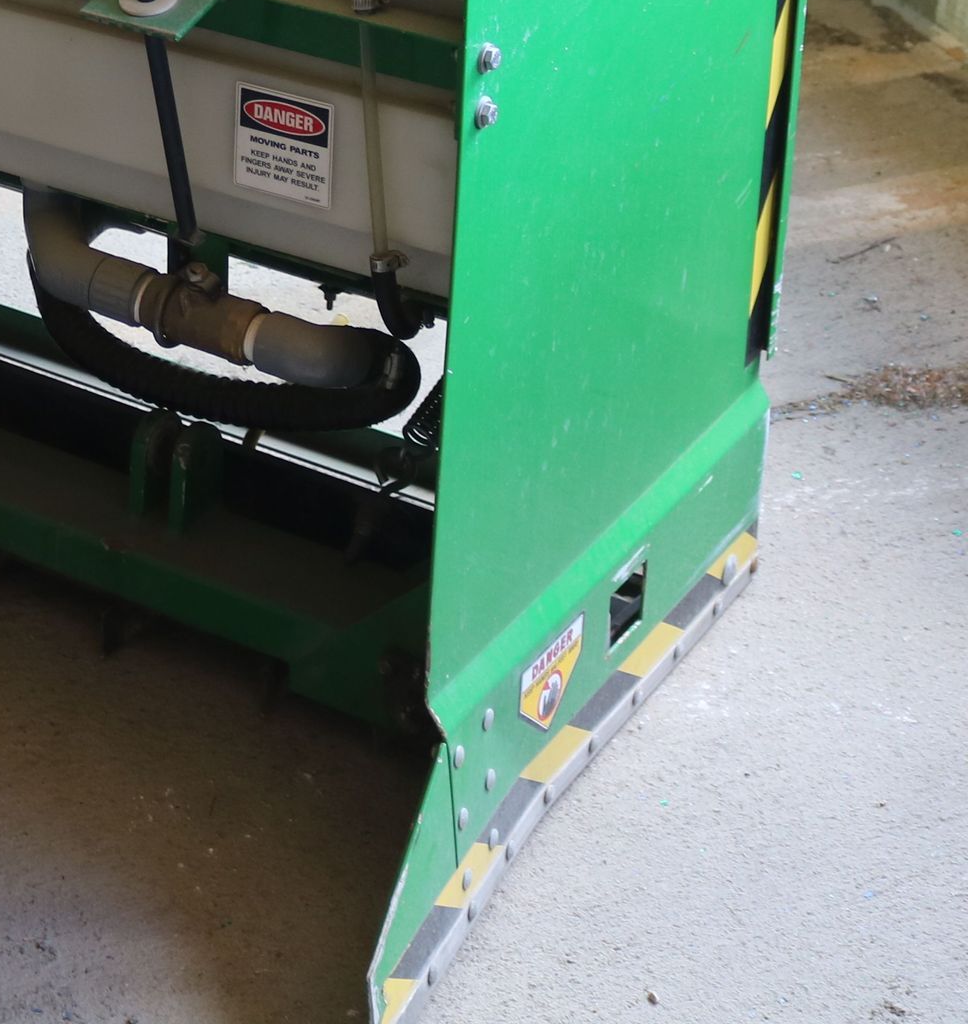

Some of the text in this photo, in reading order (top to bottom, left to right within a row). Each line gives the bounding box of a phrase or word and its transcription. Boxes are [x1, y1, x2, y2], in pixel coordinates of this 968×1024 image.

[253, 103, 314, 132] DANGER
[249, 135, 320, 159] MOVING PARTS
[240, 156, 271, 170] FINGERS
[296, 170, 326, 184] SEVERE
[250, 149, 316, 172] KEEP HANDS AND
[246, 167, 271, 178] INJURY
[273, 174, 288, 183] MAY
[532, 628, 574, 680] DANGER
